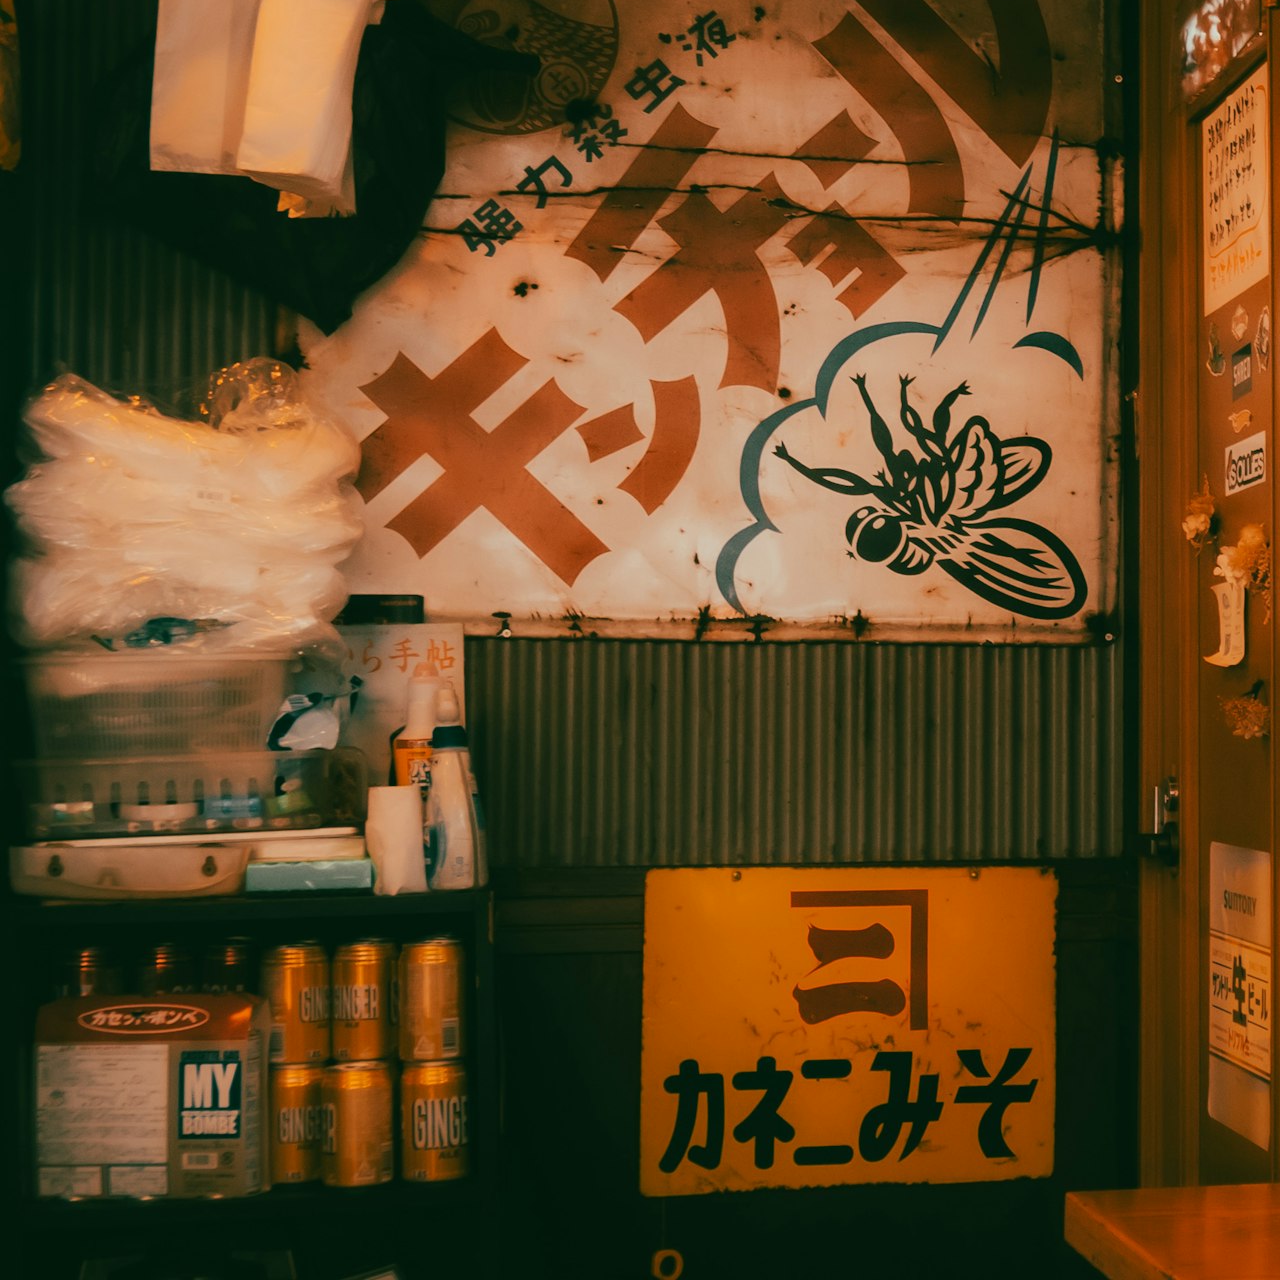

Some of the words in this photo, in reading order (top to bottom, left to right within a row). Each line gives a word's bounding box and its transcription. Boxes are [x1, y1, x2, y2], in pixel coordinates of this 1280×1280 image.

[1223, 888, 1258, 918] SUNTORY
[182, 1062, 239, 1109] MY
[181, 1111, 239, 1136] BOMBE
